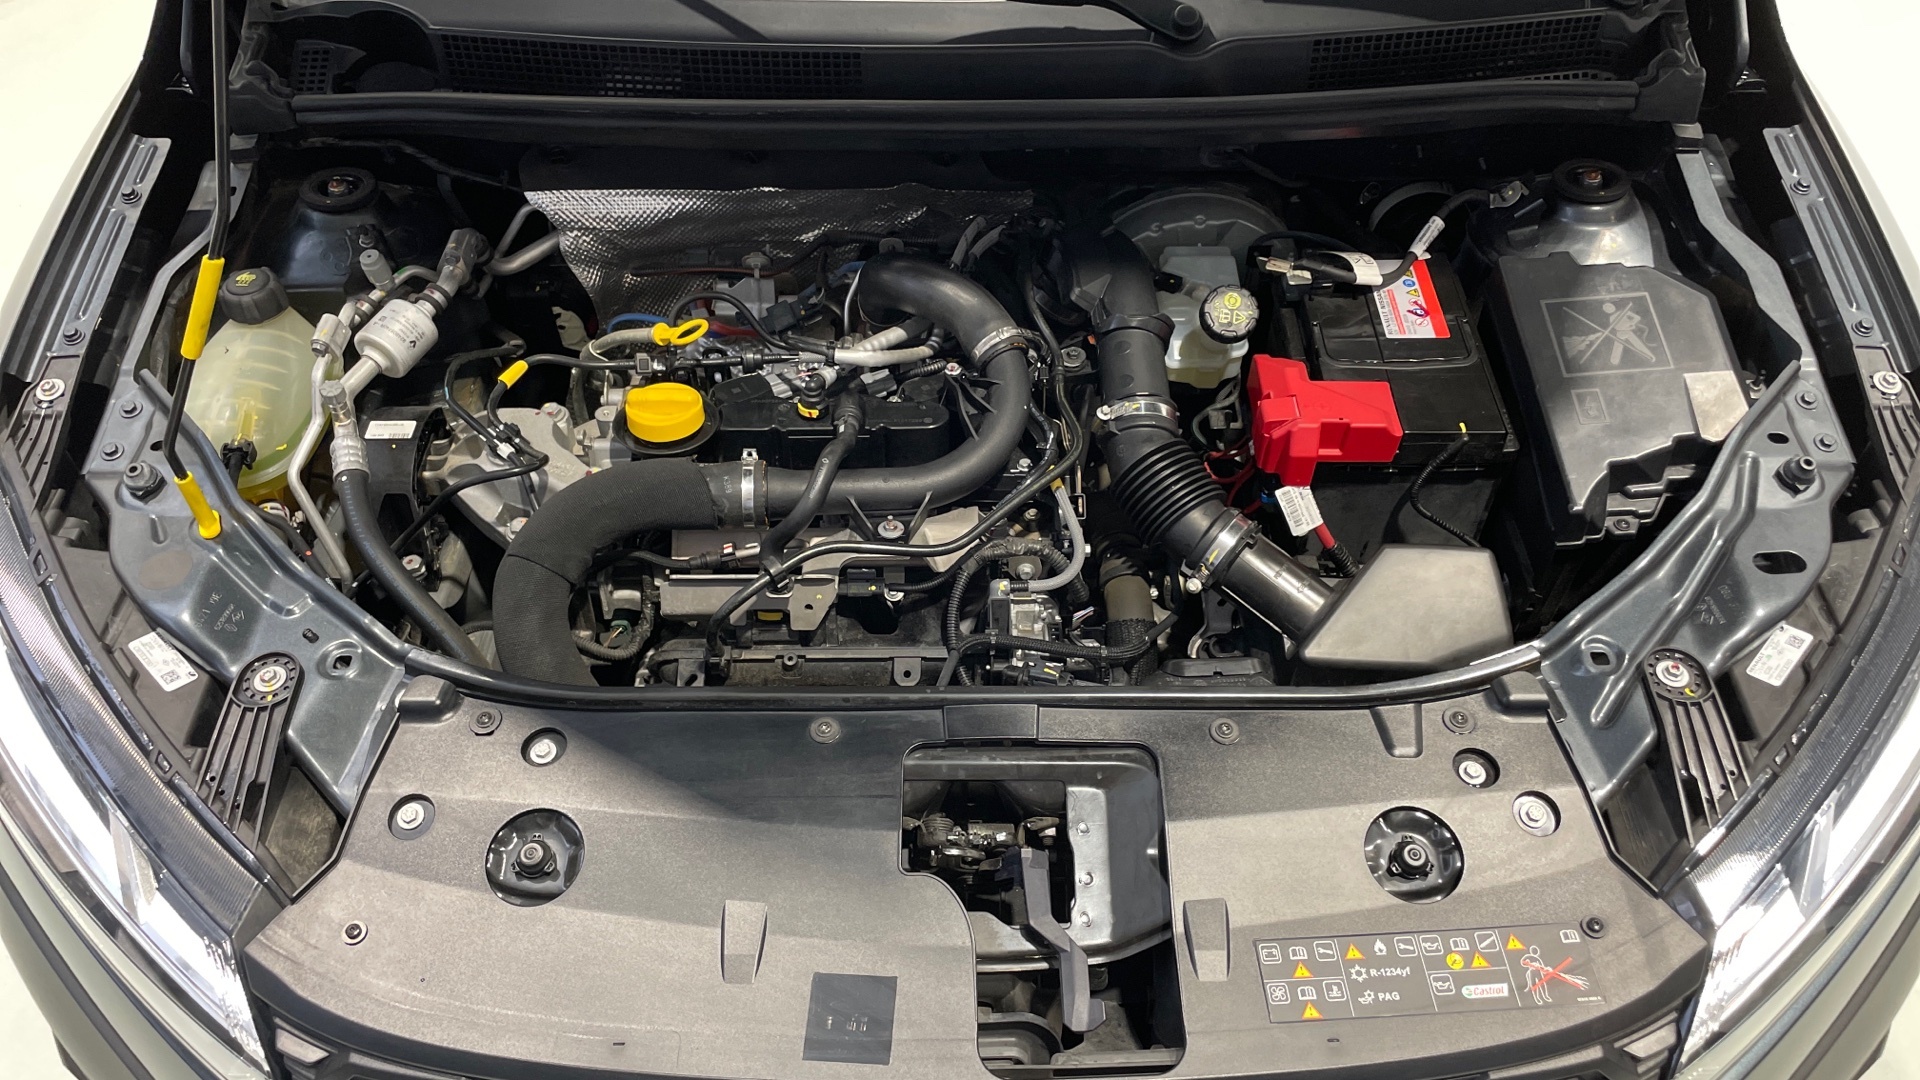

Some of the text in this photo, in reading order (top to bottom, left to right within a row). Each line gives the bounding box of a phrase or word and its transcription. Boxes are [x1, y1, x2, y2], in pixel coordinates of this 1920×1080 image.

[1382, 311, 1393, 335] RENAULT
[1748, 652, 1765, 673] RENAULT
[1378, 991, 1400, 1001] PAG
[1473, 986, 1505, 996] Castrol
